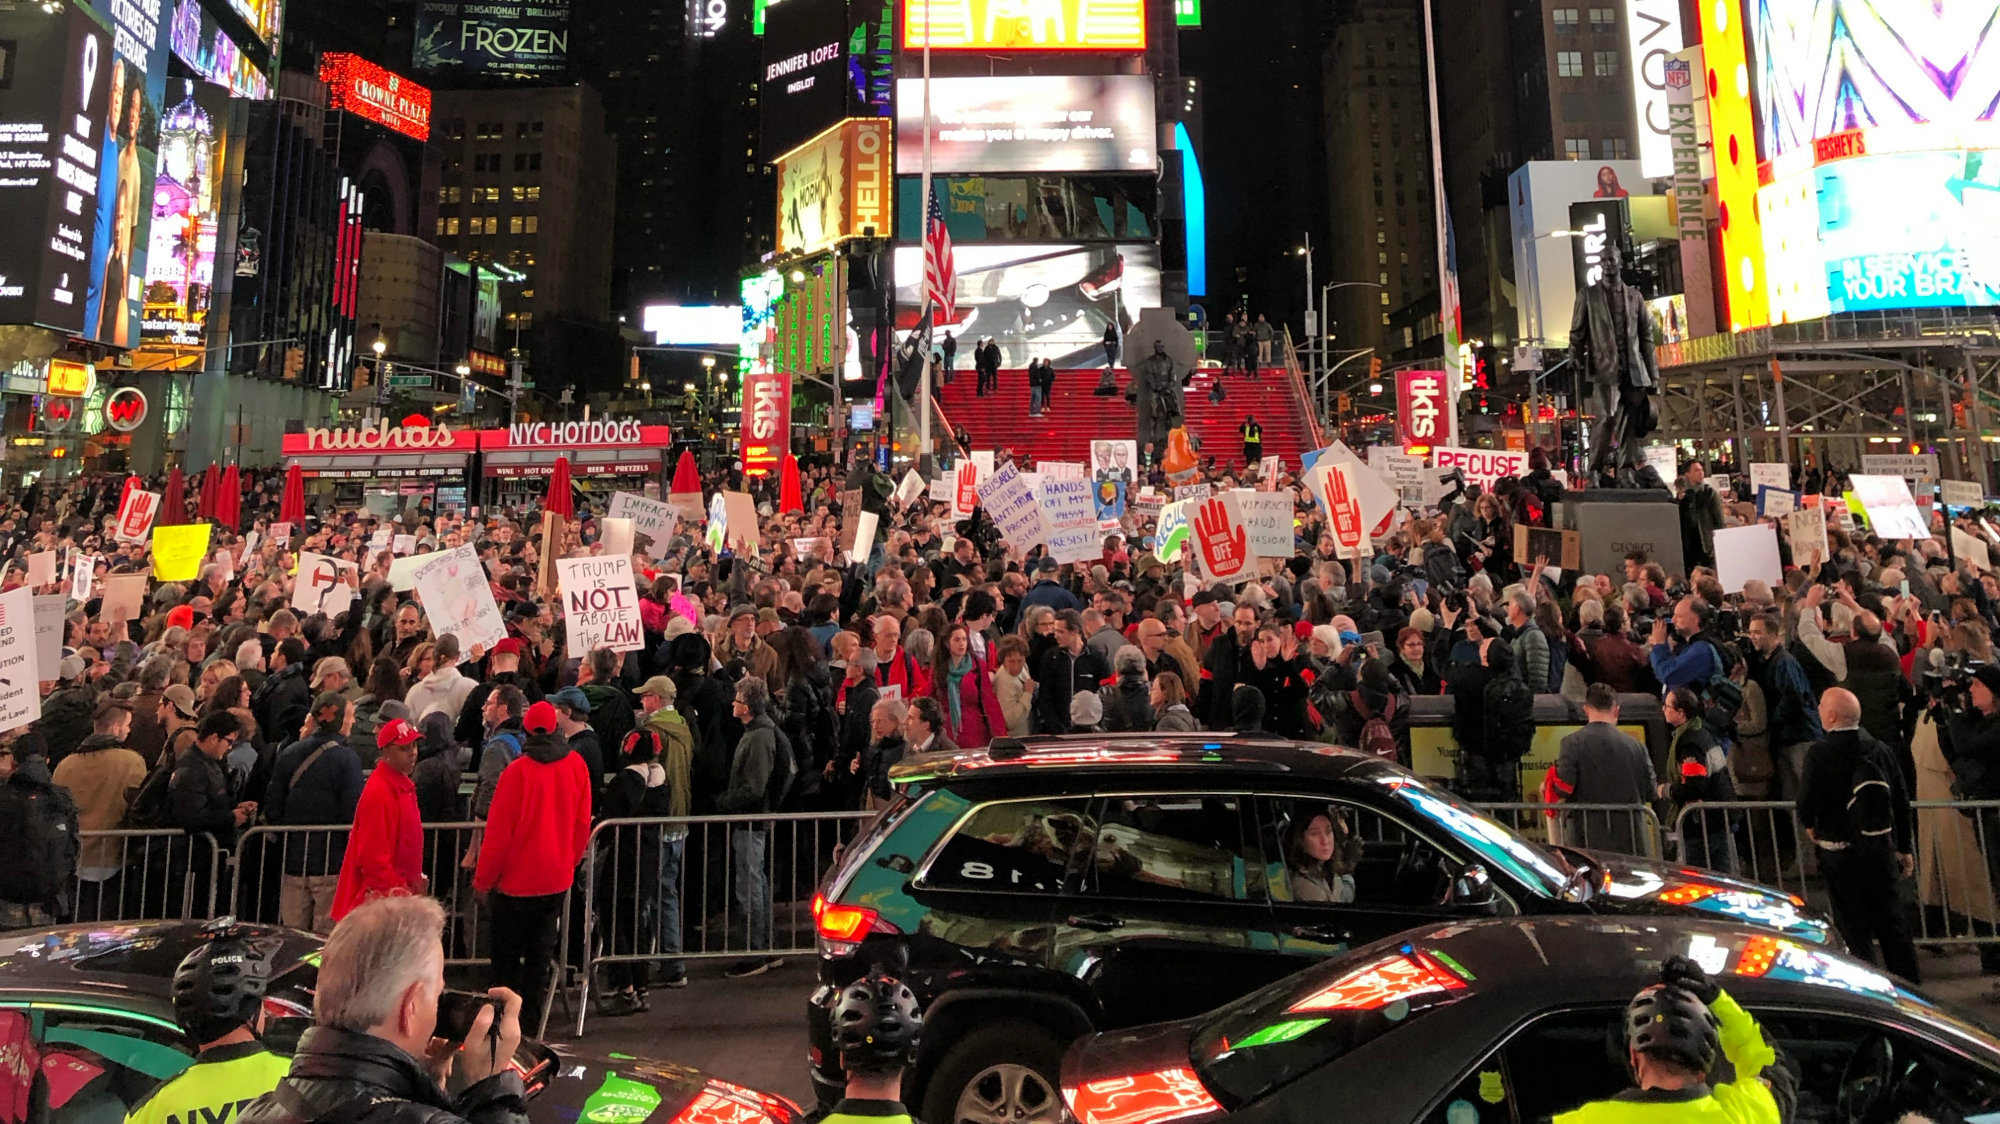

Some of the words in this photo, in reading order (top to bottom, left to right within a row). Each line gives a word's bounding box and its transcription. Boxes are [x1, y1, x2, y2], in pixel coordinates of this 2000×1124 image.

[460, 20, 568, 58] FROZEN
[766, 53, 808, 82] JENNIFER
[810, 42, 840, 65] LOPEZ
[787, 77, 815, 94] INGLOT
[1666, 71, 1690, 86] NFL
[355, 78, 396, 109] CROWNE
[399, 97, 427, 123] PLAZA
[381, 111, 400, 128] HOTEL
[986, 128, 1013, 142] you
[1071, 125, 1114, 140] driver.
[1817, 131, 1865, 162] HERSHEY'S
[857, 124, 880, 233] HELLO!
[1668, 103, 1707, 241] EXPERIENCE
[1843, 273, 1907, 300] YOUR
[381, 364, 393, 400] FROZEN
[753, 379, 782, 439] tkts
[1410, 377, 1440, 438] tkts
[306, 417, 455, 449] nuchas
[509, 422, 546, 445] NYC
[615, 464, 649, 472] PRETZELS
[1438, 452, 1522, 478] RECUSE
[1045, 481, 1086, 495] HANDS
[1180, 485, 1209, 496] OUR
[623, 497, 674, 520] IMPEACH
[1069, 494, 1085, 504] MY
[1241, 500, 1293, 512] NSPIRACY!
[1338, 514, 1353, 531] OFF
[1016, 523, 1041, 546] SIGN
[1250, 535, 1291, 546] VASION!
[454, 547, 472, 560] ASS
[1211, 542, 1233, 562] OFF
[1611, 541, 1655, 553] GEORGE
[568, 559, 626, 579] TRUMP
[1213, 558, 1241, 573] MUELLER
[593, 578, 606, 588] IS
[570, 586, 630, 612] NOT
[580, 610, 627, 627] ABOVE
[604, 619, 640, 643] LAW
[8, 706, 30, 720] Law!
[211, 955, 243, 966] POLICE
